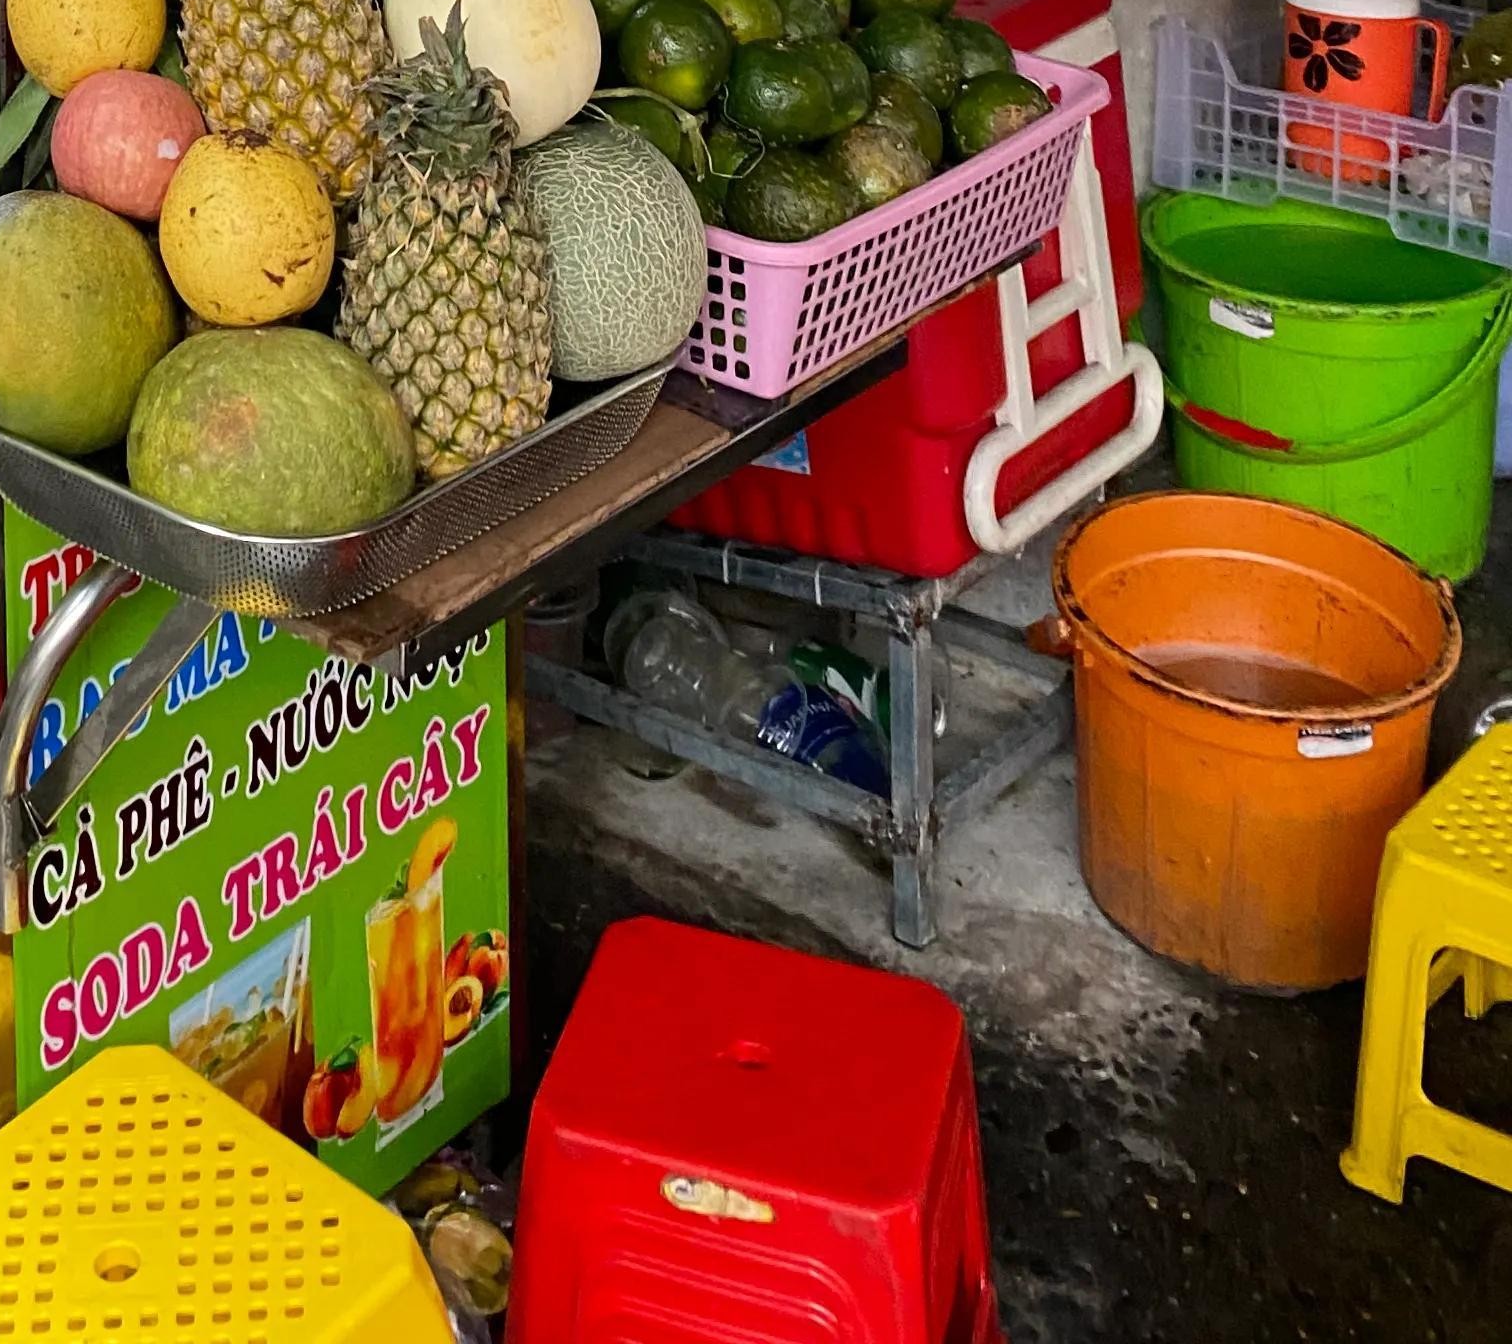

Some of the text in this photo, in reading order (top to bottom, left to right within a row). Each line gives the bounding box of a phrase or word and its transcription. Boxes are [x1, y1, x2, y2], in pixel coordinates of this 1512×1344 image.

[39, 705, 490, 1072] SODA TRÁI CÂY
[116, 734, 215, 877] PHÊ
[245, 653, 376, 799] NƯỚC
